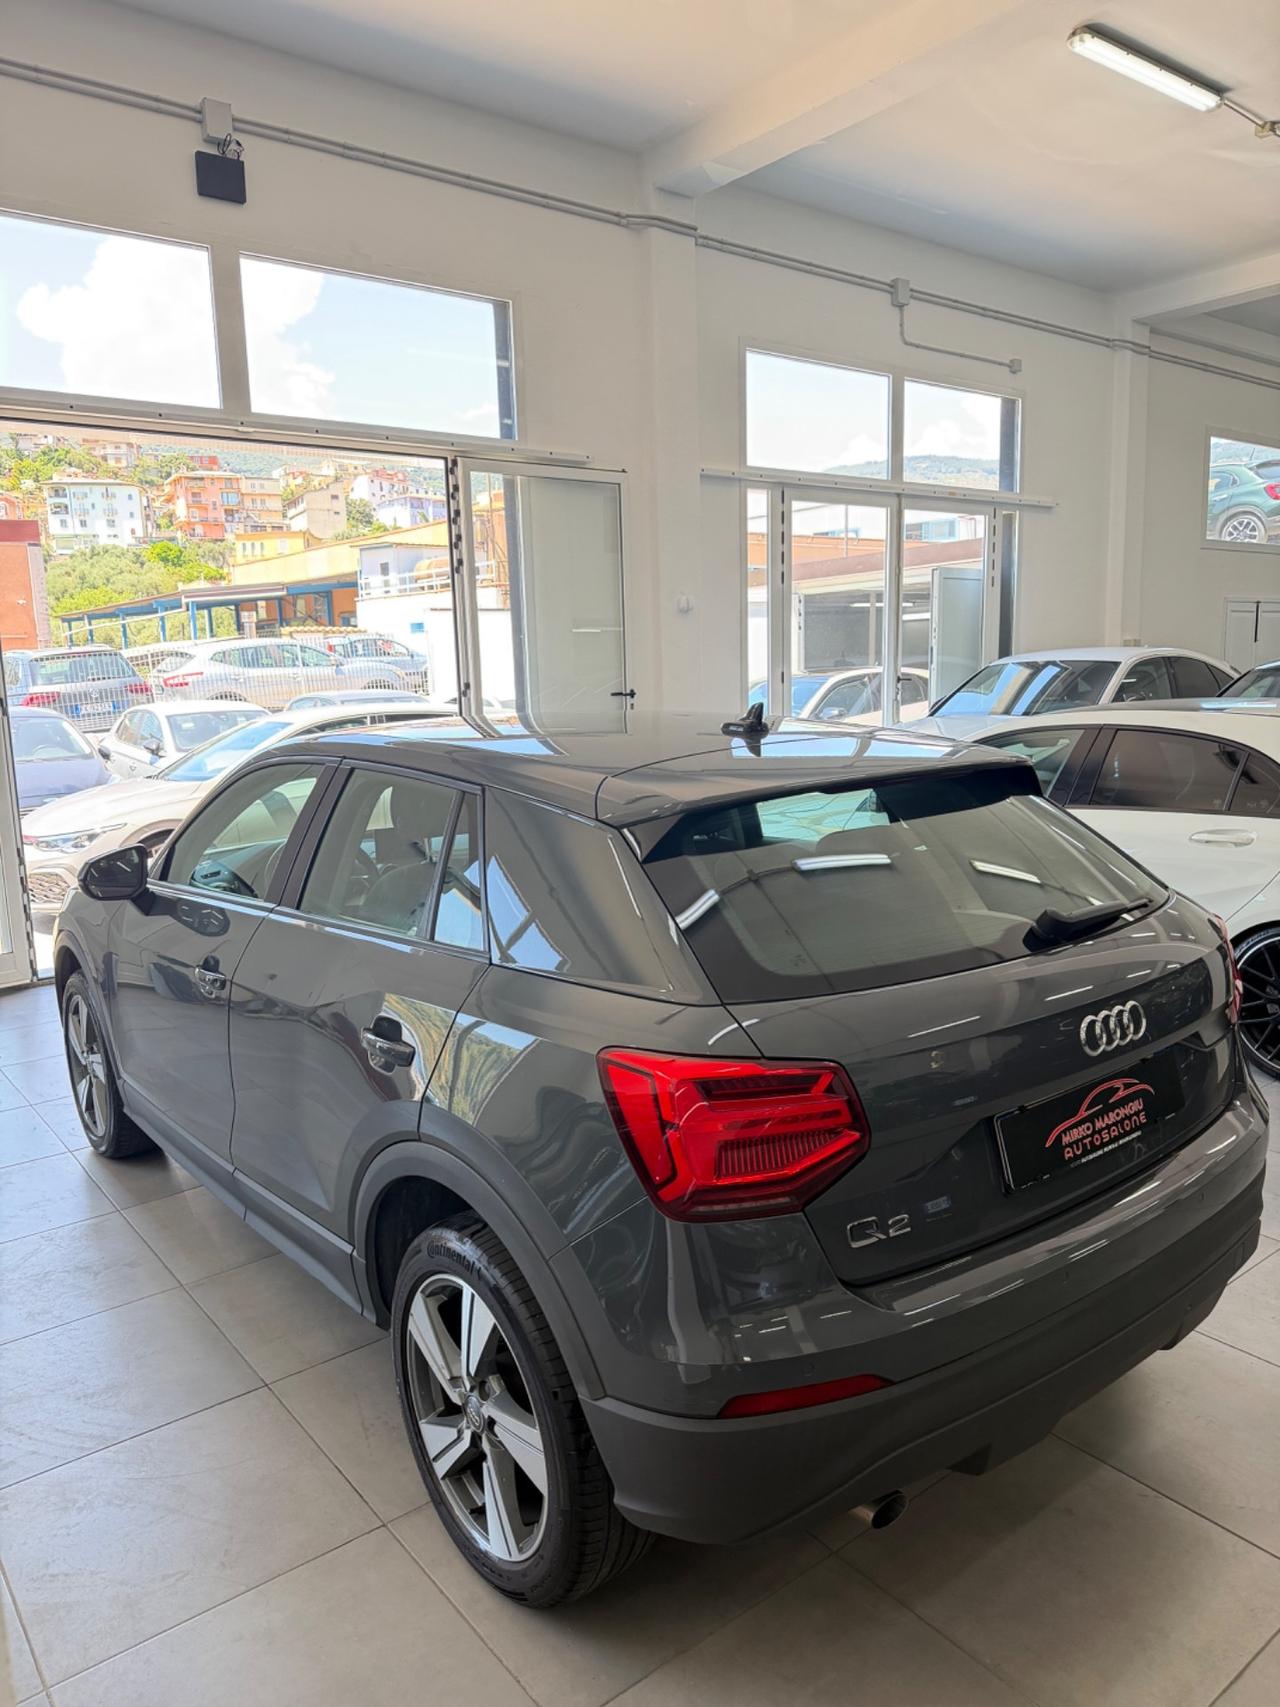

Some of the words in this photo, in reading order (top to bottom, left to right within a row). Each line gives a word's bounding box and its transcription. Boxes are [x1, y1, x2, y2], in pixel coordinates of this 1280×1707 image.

[1061, 1122, 1093, 1146] MIRKO
[1094, 1097, 1144, 1131] MARONGIU
[846, 1213, 912, 1249] Q2
[426, 1239, 475, 1276] Continental
